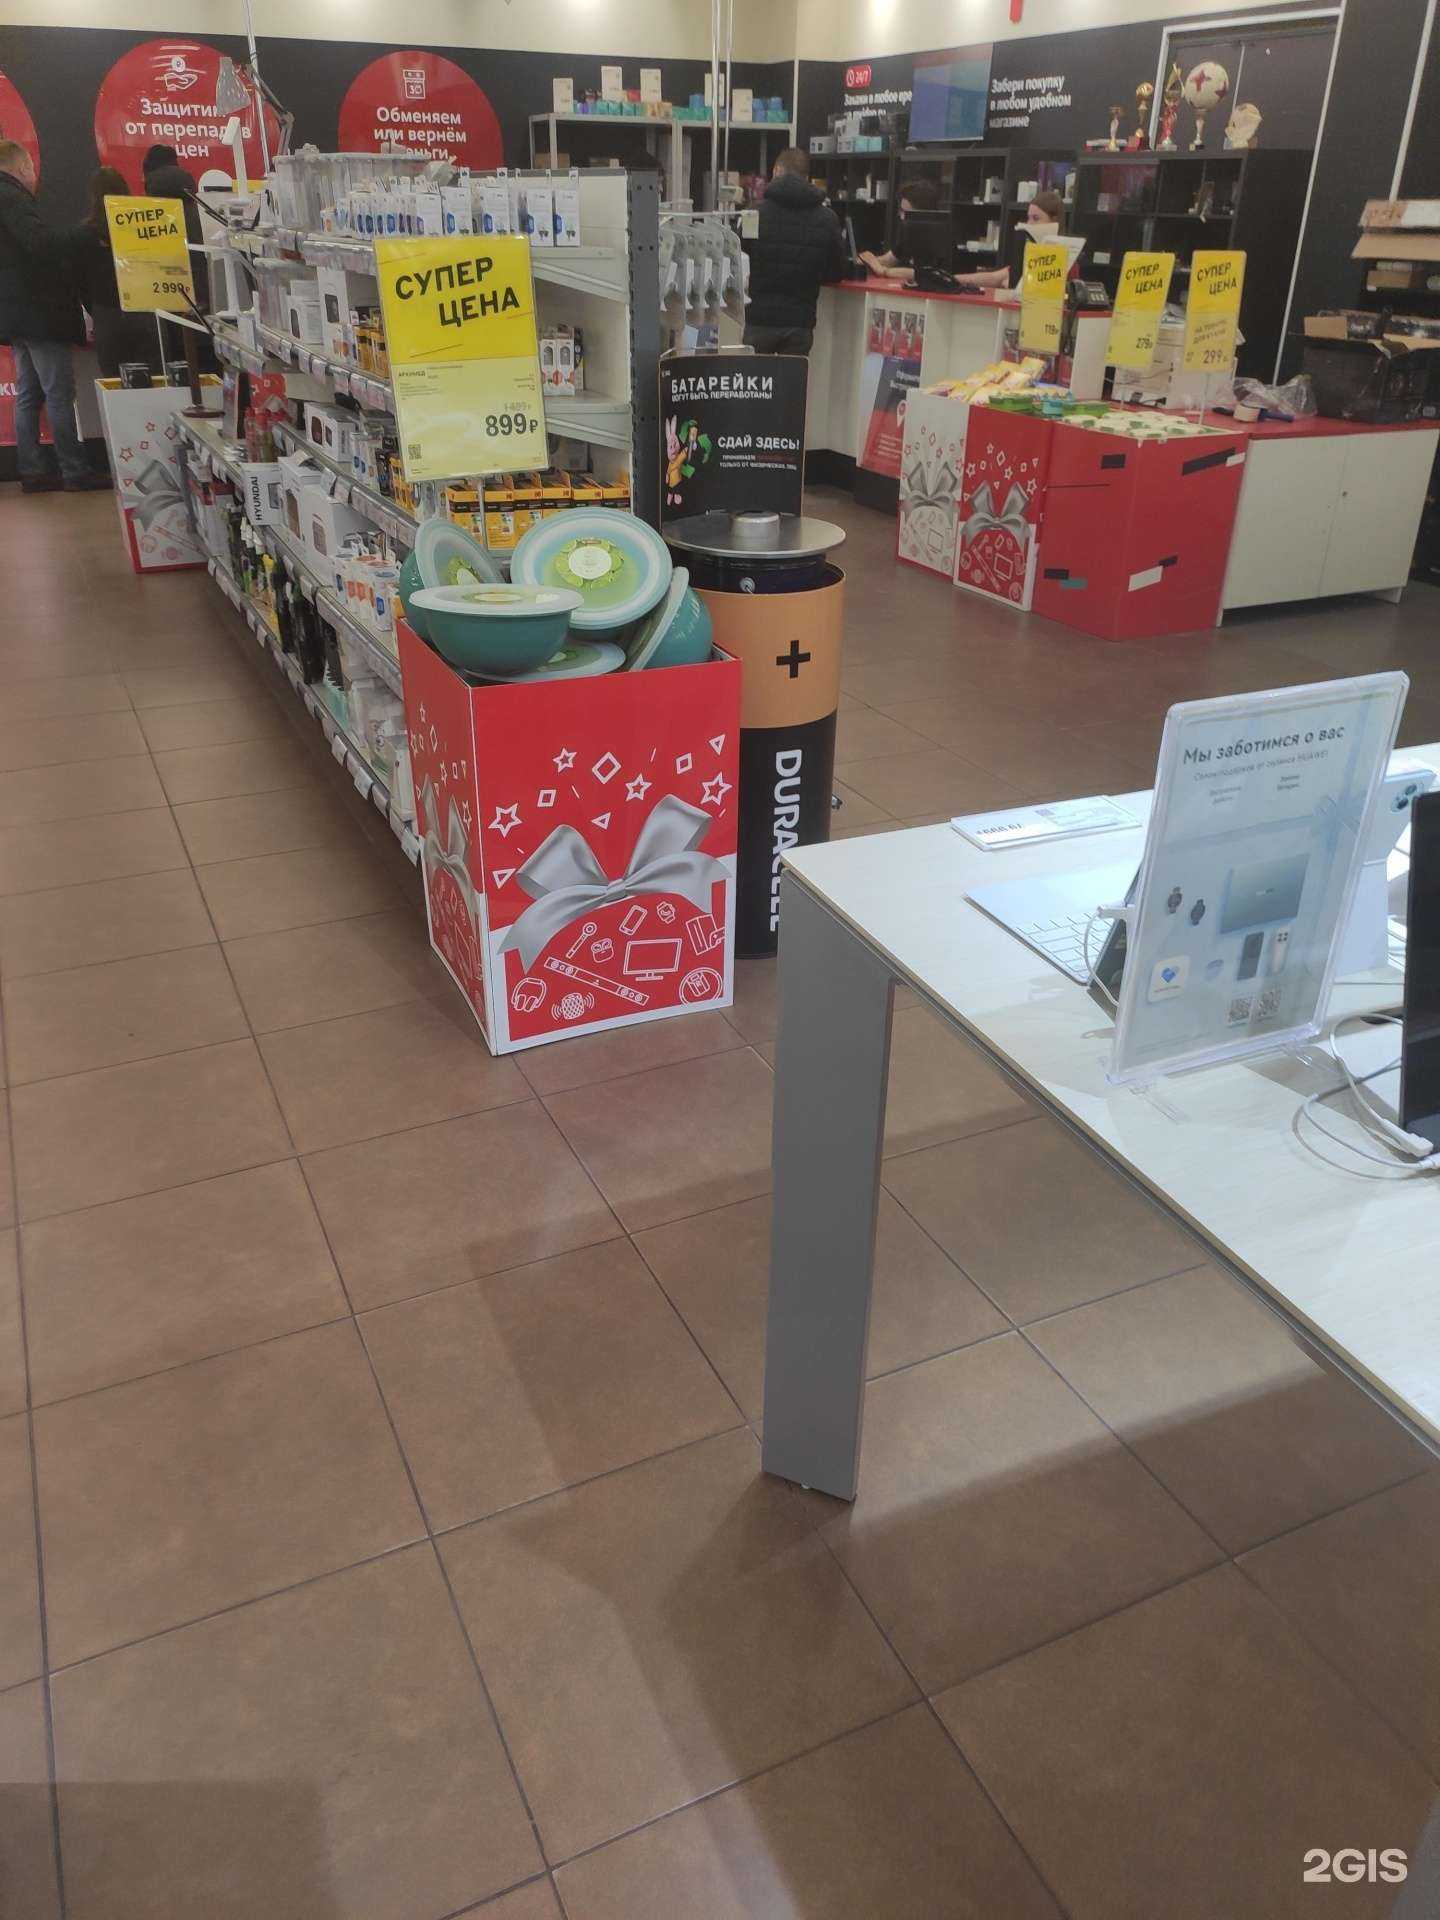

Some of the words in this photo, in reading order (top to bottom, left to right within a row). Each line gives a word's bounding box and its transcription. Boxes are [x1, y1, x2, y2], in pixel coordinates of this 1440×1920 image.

[991, 77, 1024, 98] Забери
[1025, 75, 1065, 94] покупку
[899, 91, 913, 106] вре
[990, 100, 996, 111] в
[996, 96, 1028, 110] любом
[1028, 92, 1072, 113] удобном
[376, 107, 461, 124] Обменяем
[989, 116, 1030, 128] магазине
[125, 121, 147, 135] от
[374, 128, 404, 141] или
[408, 127, 467, 146] вернём
[175, 144, 210, 159] цен
[406, 147, 449, 160] еньги
[115, 208, 165, 226] СУПЕР
[137, 223, 179, 241] ЦЕНА
[1028, 254, 1057, 268] СУПЕР
[395, 256, 494, 300] СУПЕР
[1037, 269, 1062, 282] ЦЕНА
[1125, 263, 1160, 280] СУПЕР
[1197, 262, 1232, 281] СУПЕР
[1135, 279, 1165, 295] ЦЕНА
[1209, 277, 1239, 296] ЦЕНА
[438, 286, 520, 327] ЦЕНА
[671, 373, 773, 394] БАТАРЕЙКИ
[710, 390, 773, 400] ПЕРЕРАБОТАНЫ
[717, 433, 752, 449] СДАЙ
[756, 436, 800, 450] ЗДЕСЬ!
[248, 476, 263, 521] HYUNDAI
[1183, 748, 1211, 765] Мы
[1215, 734, 1300, 760] заботимся
[1304, 732, 1314, 743] о
[1318, 726, 1346, 742] вас
